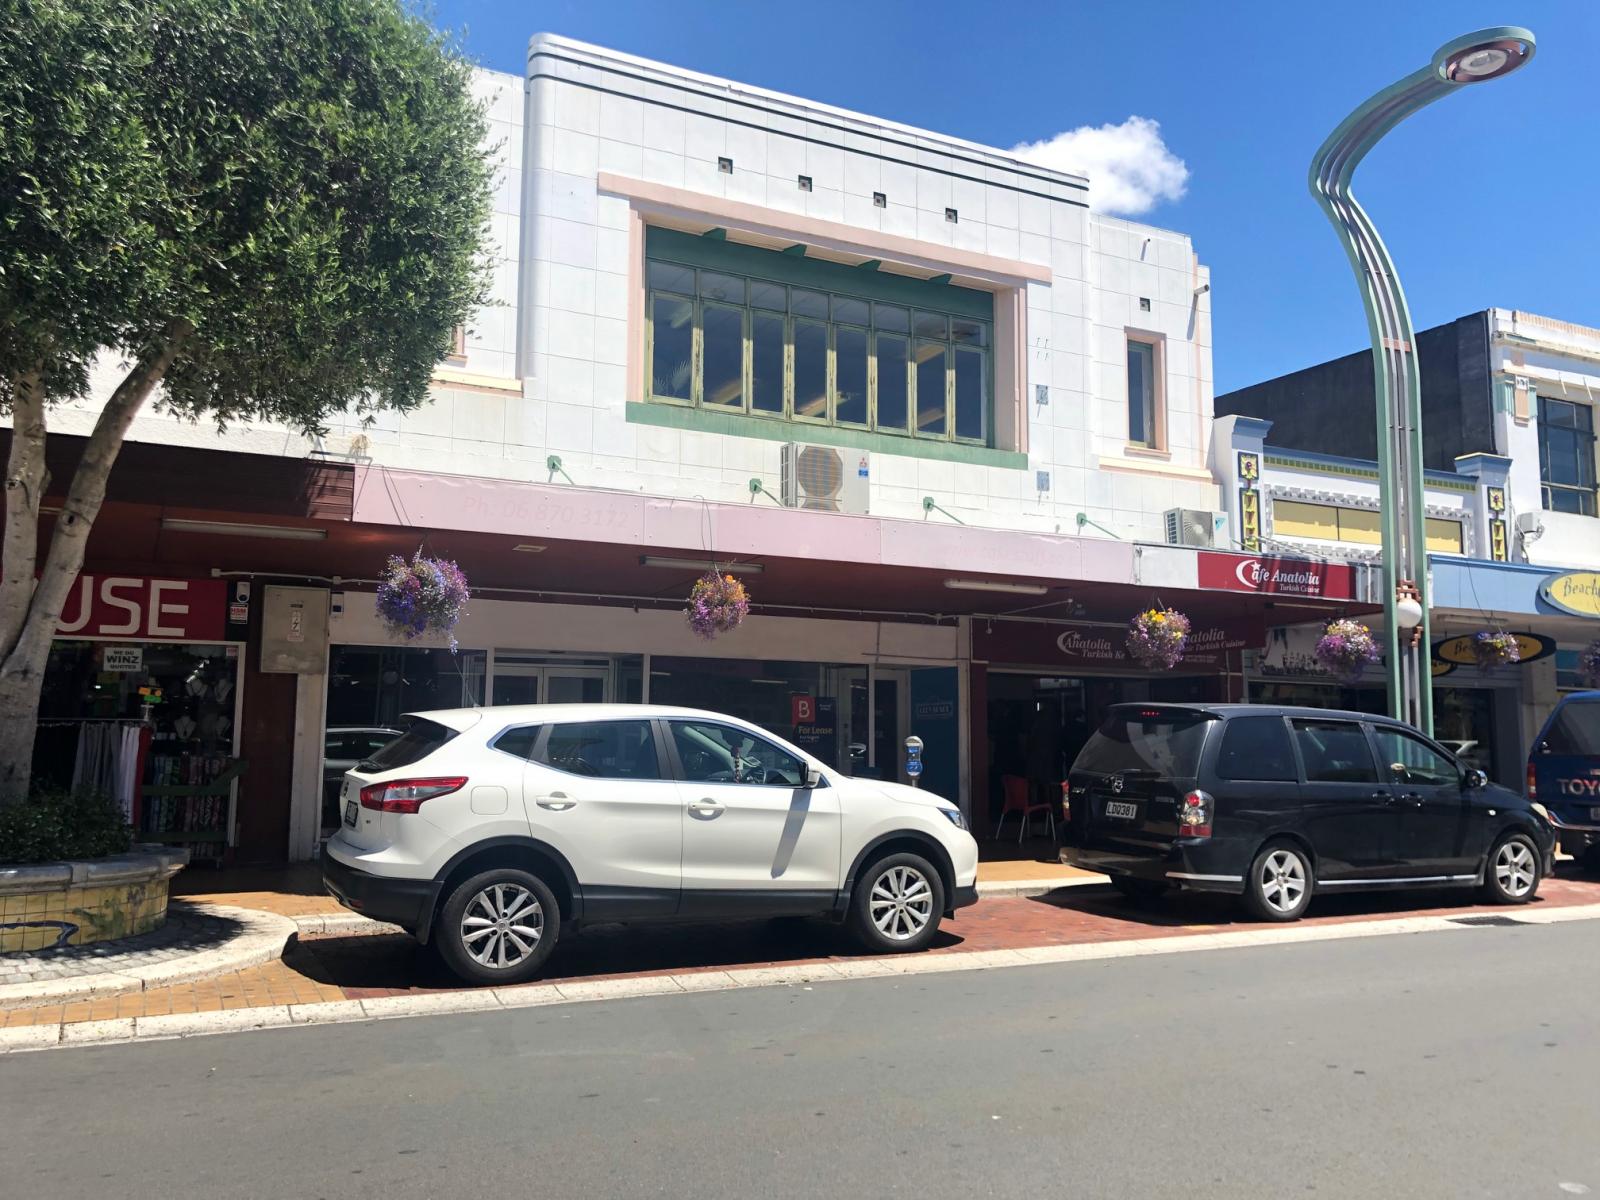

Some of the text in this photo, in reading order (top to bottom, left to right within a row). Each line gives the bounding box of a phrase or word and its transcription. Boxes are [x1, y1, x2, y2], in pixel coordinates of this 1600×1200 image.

[1271, 569, 1320, 585] Anatolia
[1280, 584, 1300, 592] Turkish
[34, 575, 190, 637] USE
[1064, 637, 1112, 650] Anatolia
[106, 656, 140, 664] WINZ
[1081, 649, 1113, 658] Turkish
[798, 700, 810, 718] B
[812, 726, 833, 735] Lease
[1555, 778, 1600, 796] TOY
